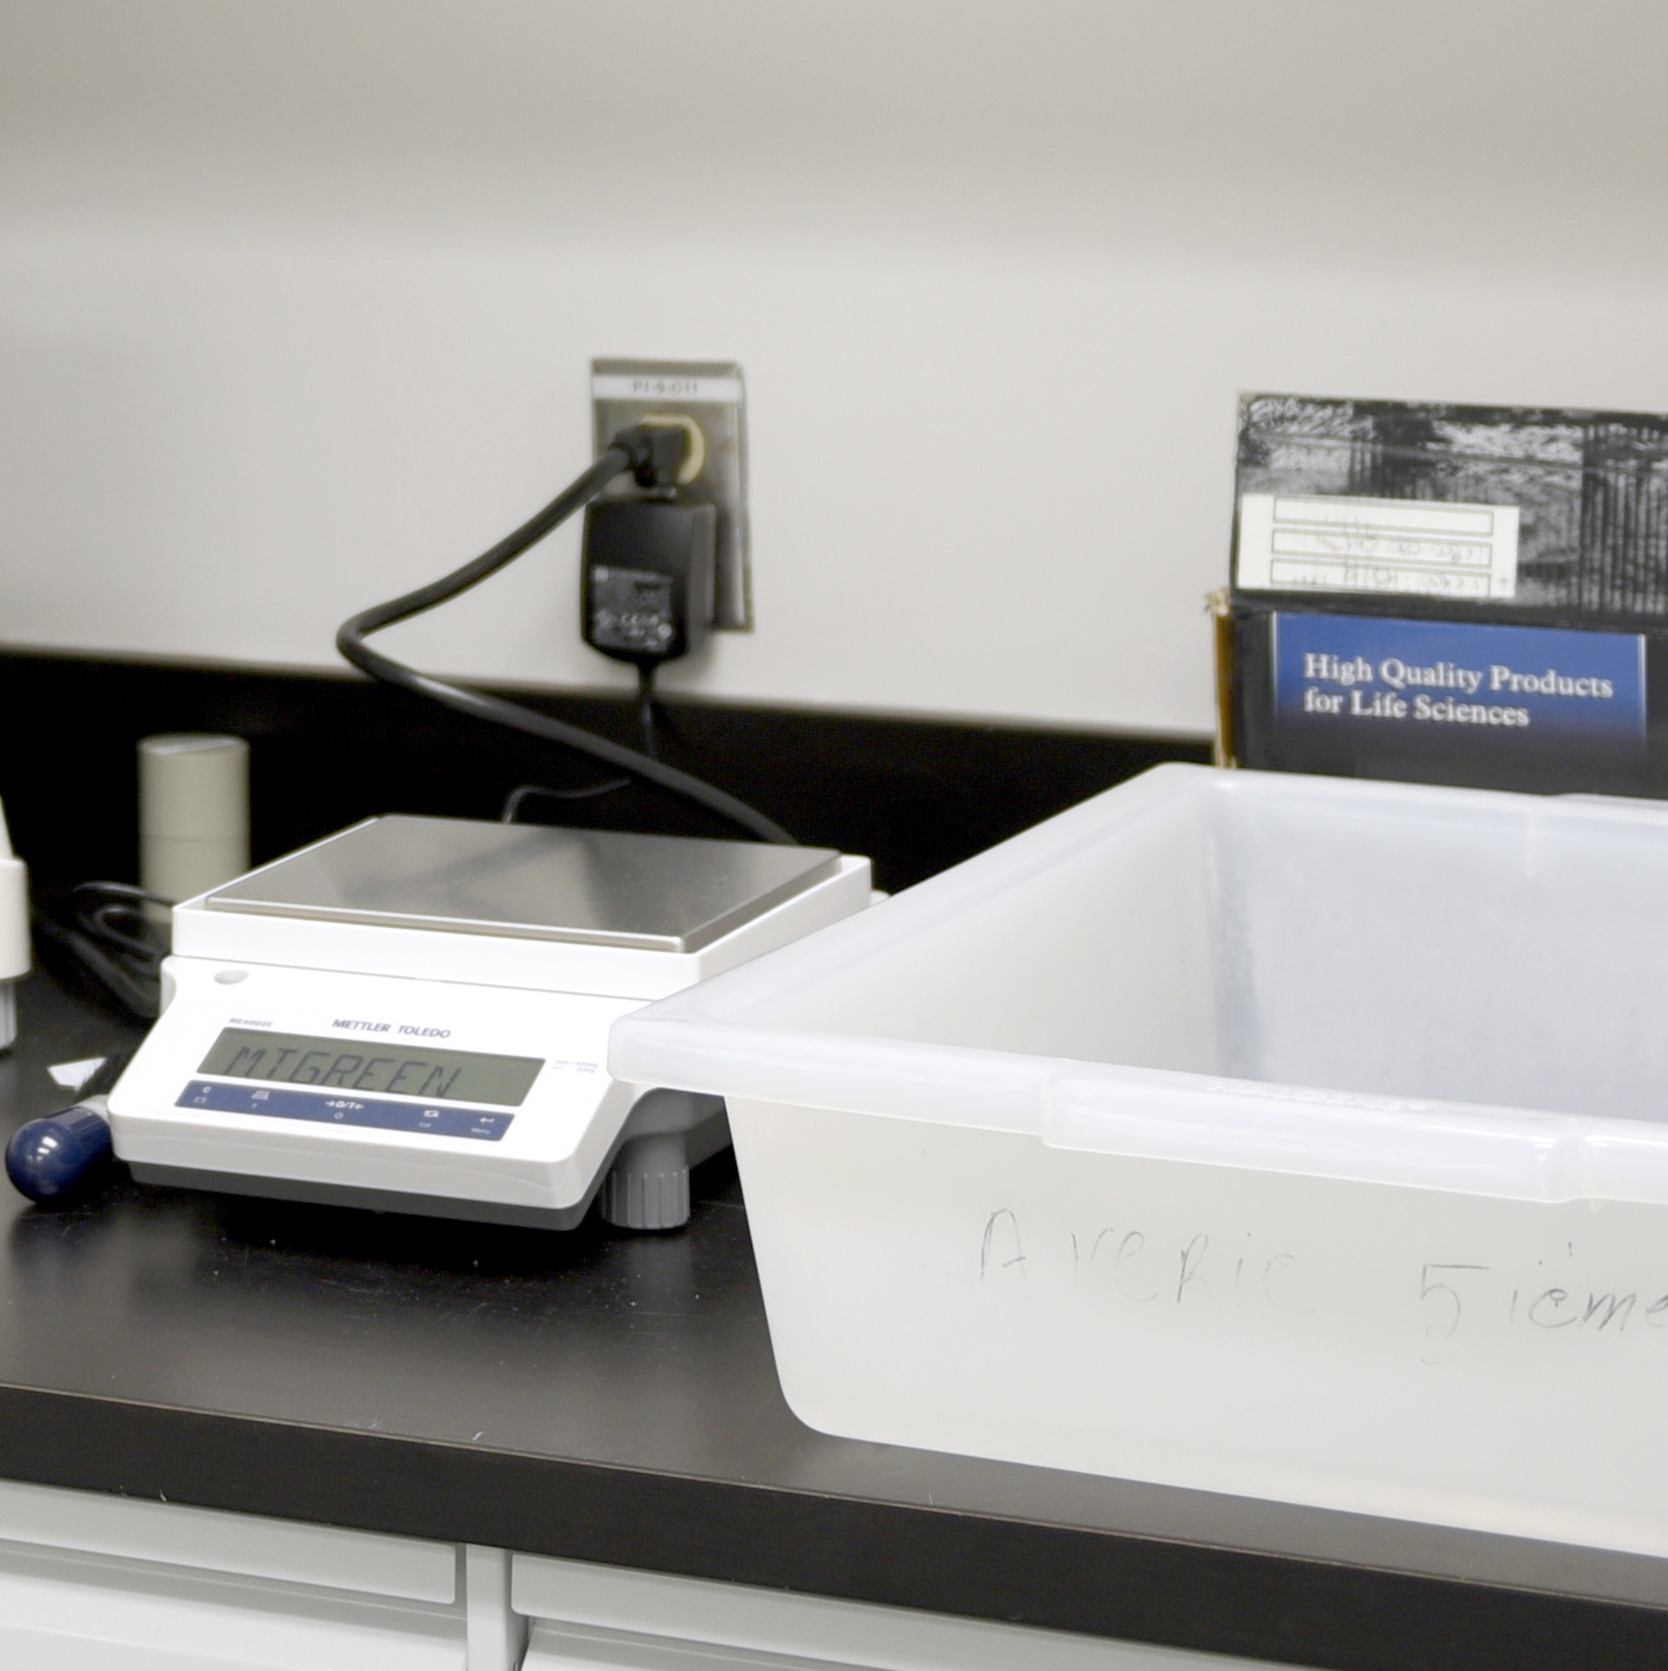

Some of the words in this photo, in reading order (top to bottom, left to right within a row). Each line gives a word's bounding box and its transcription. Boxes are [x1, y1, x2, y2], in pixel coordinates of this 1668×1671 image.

[1303, 651, 1374, 688] High
[1378, 657, 1483, 696] Quality
[1488, 664, 1614, 700] Products
[1303, 686, 1344, 716] for
[1349, 689, 1408, 719] Life
[1413, 693, 1531, 728] Sciences
[331, 1018, 392, 1033] METTLER
[397, 1024, 452, 1040] TOLEDO
[202, 1085, 212, 1095] C
